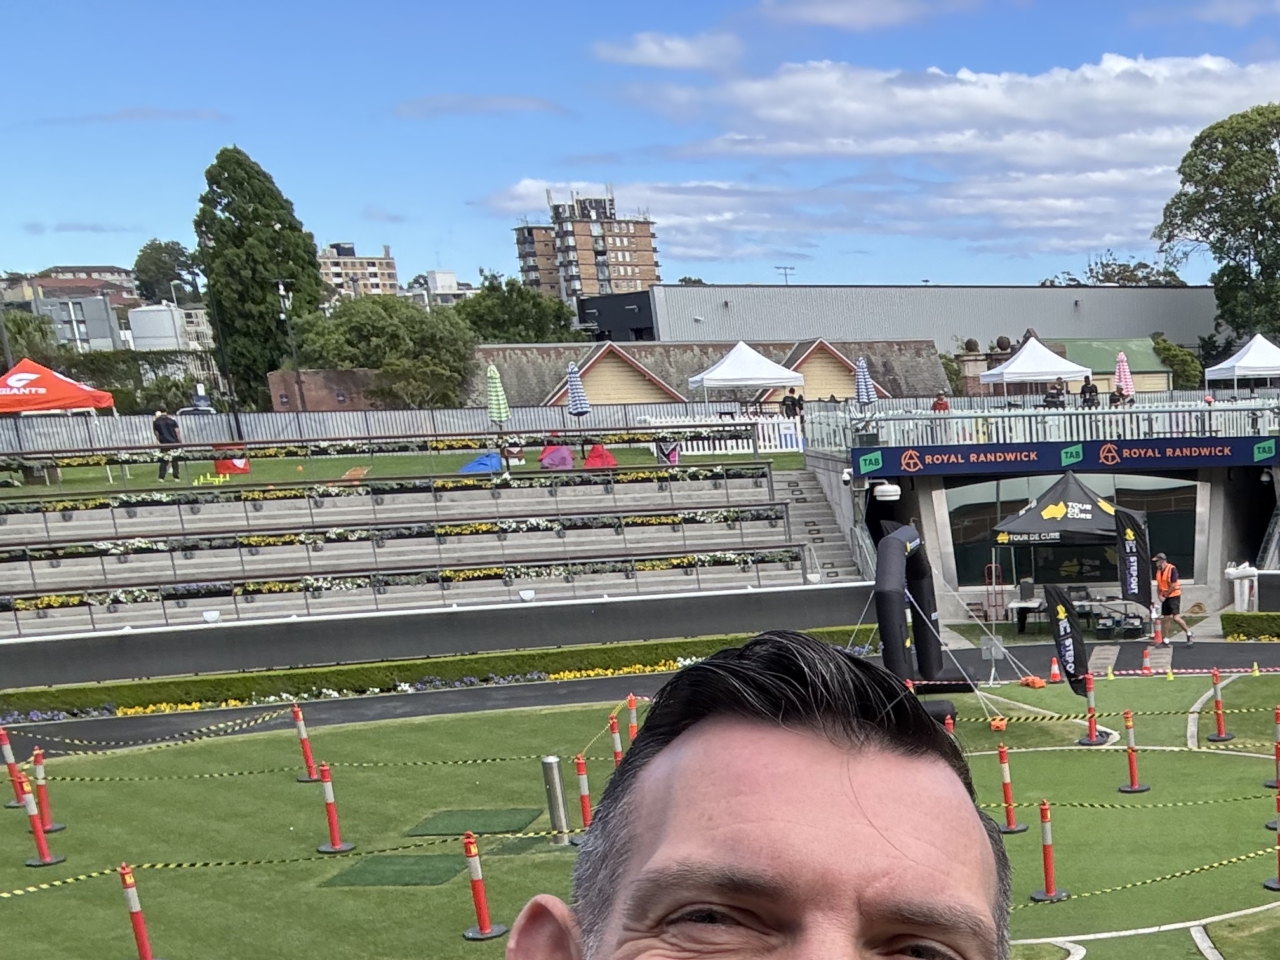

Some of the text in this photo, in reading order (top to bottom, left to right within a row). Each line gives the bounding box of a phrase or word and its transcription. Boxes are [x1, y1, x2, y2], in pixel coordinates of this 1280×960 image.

[1063, 450, 1082, 460] TAB
[1122, 446, 1232, 458] ROYAL RANDWICK
[1256, 446, 1274, 455] TAB
[925, 451, 1038, 464] ROYAL RANDWICK
[862, 458, 881, 467] TAB
[1067, 502, 1093, 510] TOUR
[1041, 532, 1061, 540] CURE
